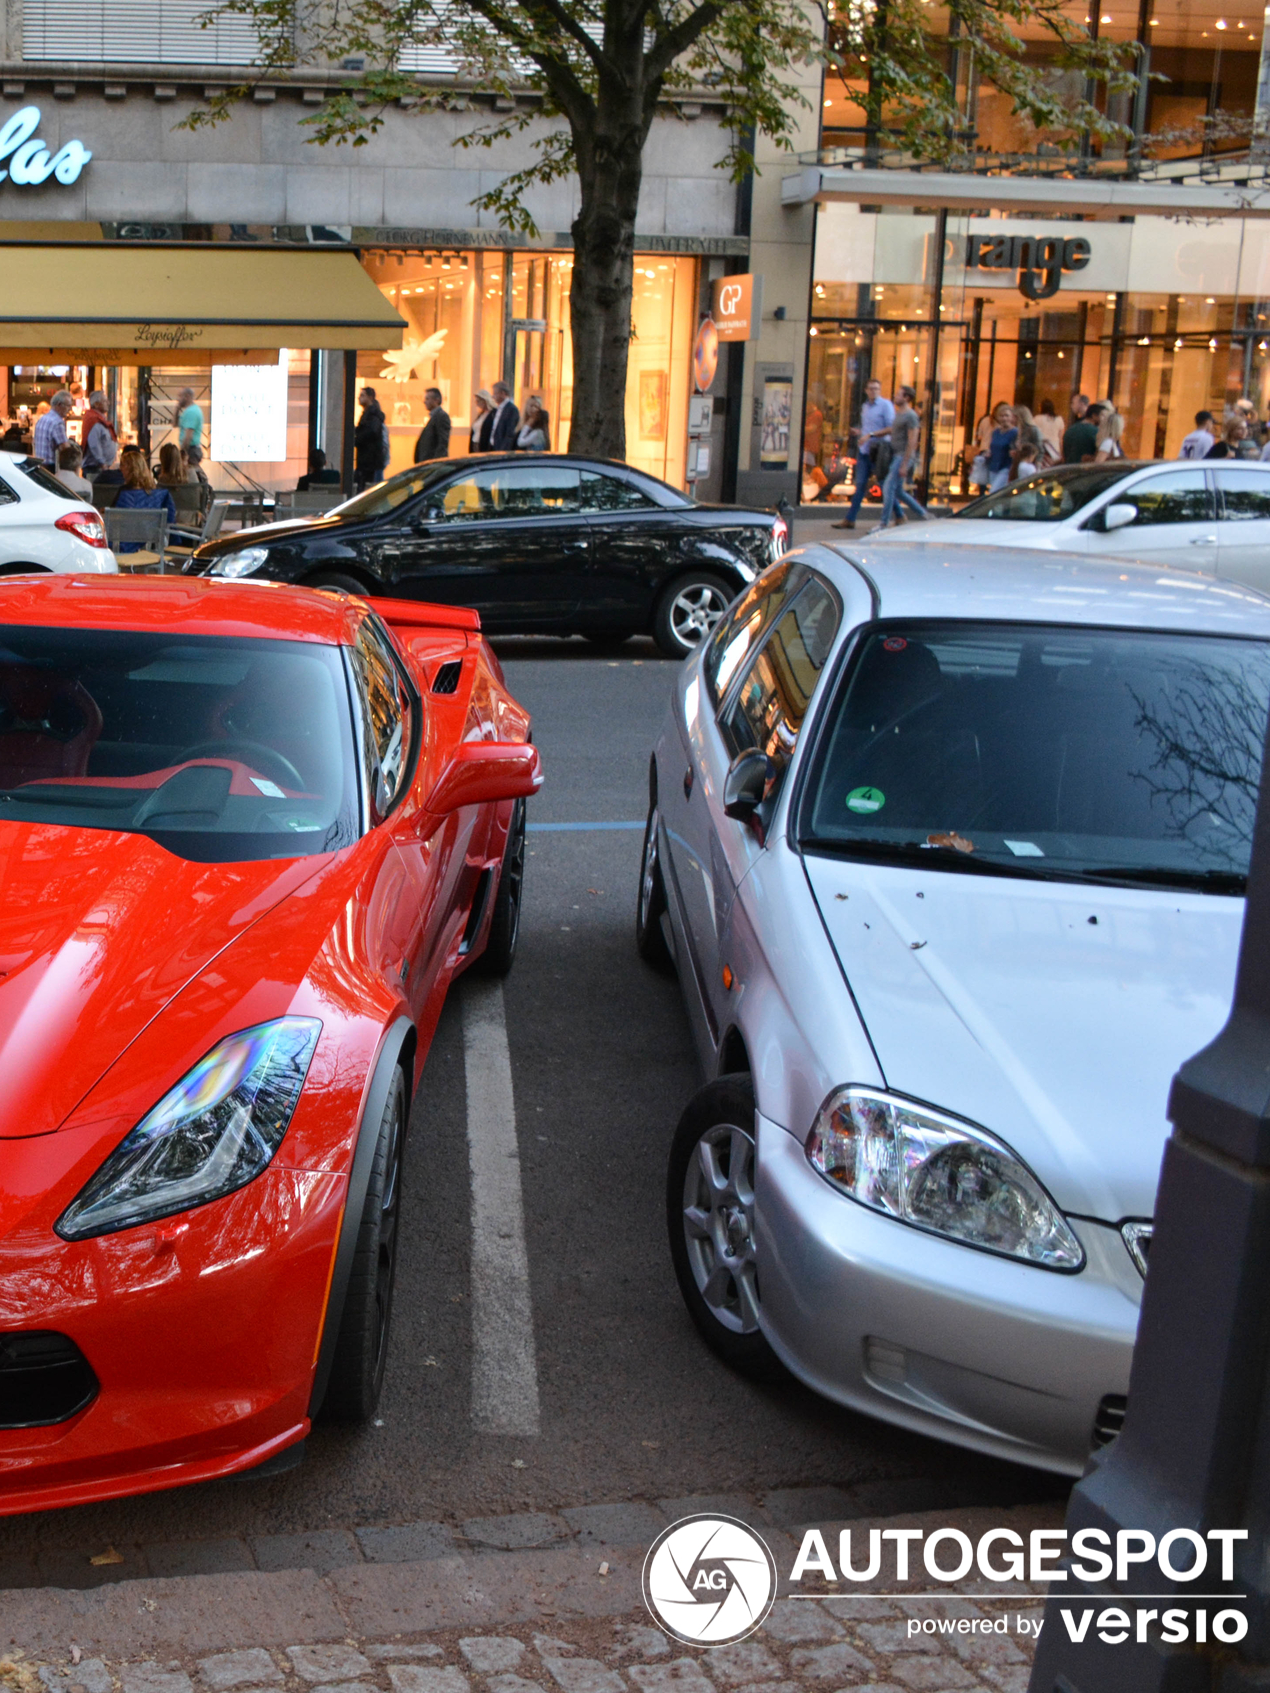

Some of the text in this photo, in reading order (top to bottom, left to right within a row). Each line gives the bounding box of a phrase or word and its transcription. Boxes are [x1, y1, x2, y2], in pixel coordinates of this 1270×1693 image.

[720, 285, 742, 315] GP
[135, 325, 202, 348] Leysieffer
[861, 788, 872, 800] 4
